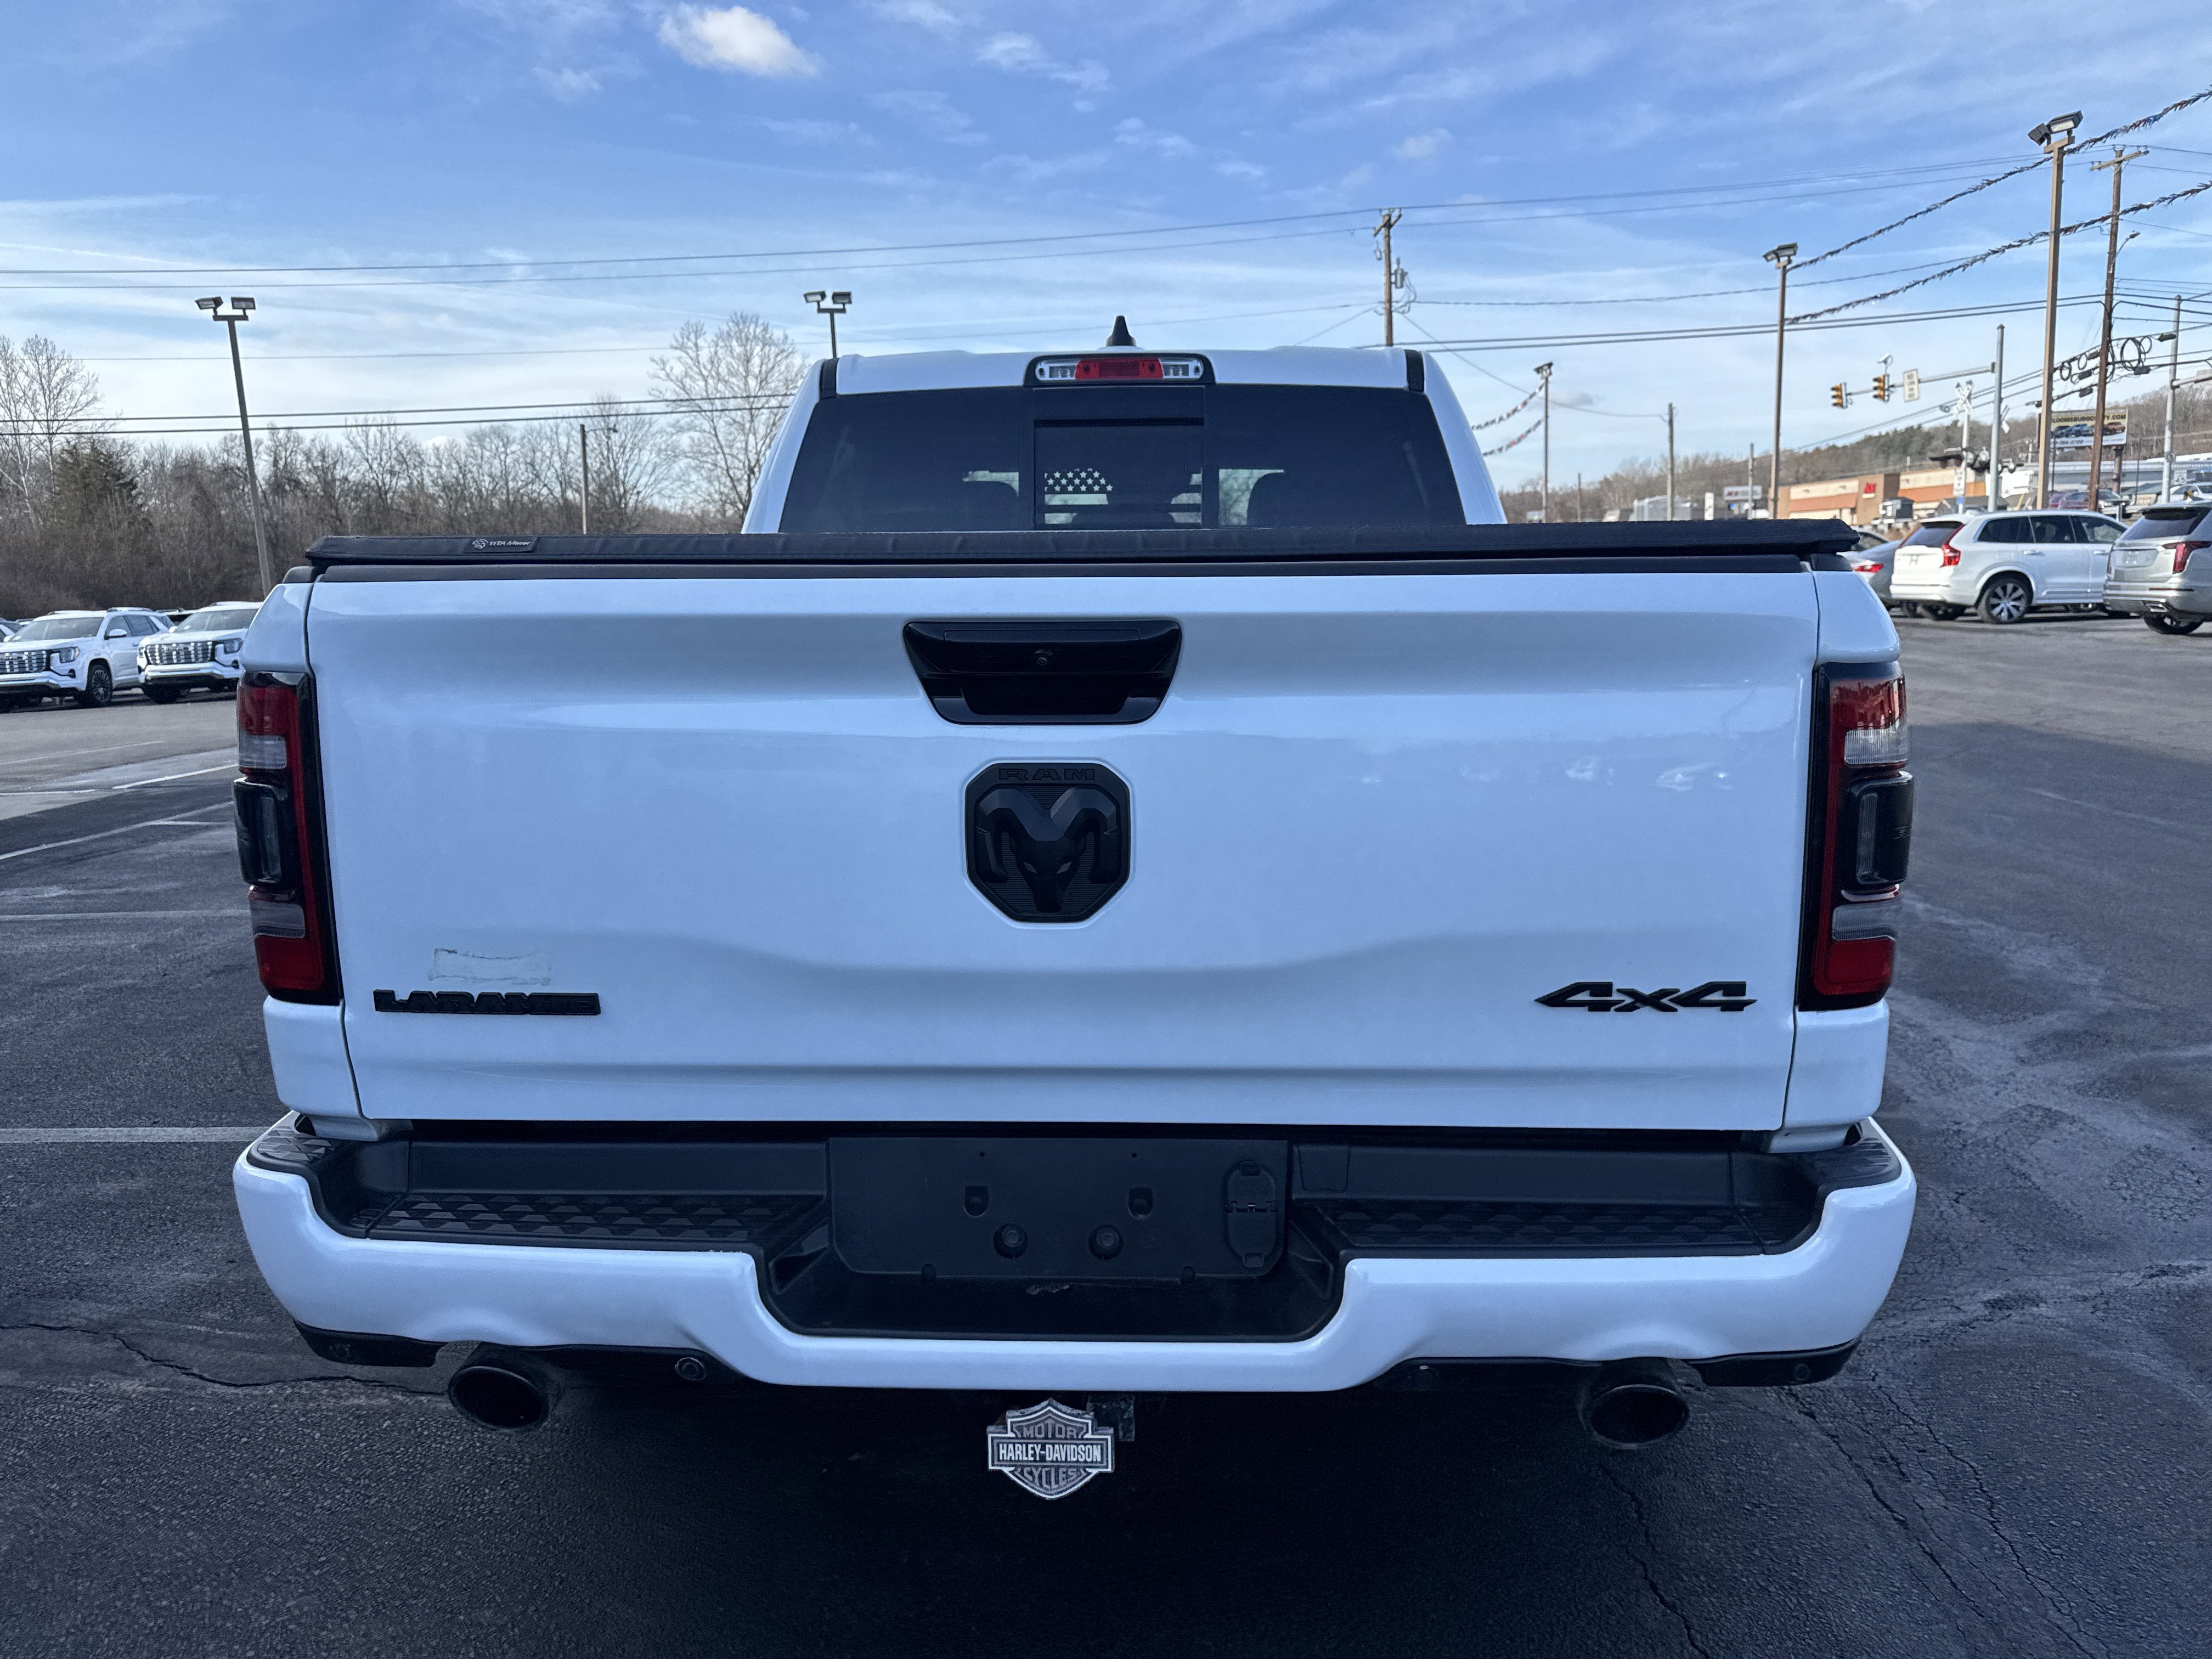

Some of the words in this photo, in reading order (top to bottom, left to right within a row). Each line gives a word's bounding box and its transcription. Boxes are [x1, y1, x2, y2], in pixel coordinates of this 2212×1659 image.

[998, 768, 1096, 781] RAM
[1533, 980, 1758, 1012] 4x4
[1023, 1419, 1077, 1439] MOTOR
[998, 1443, 1102, 1462] HARLEY-DAVIDSON
[1023, 1466, 1077, 1489] CYCLES
